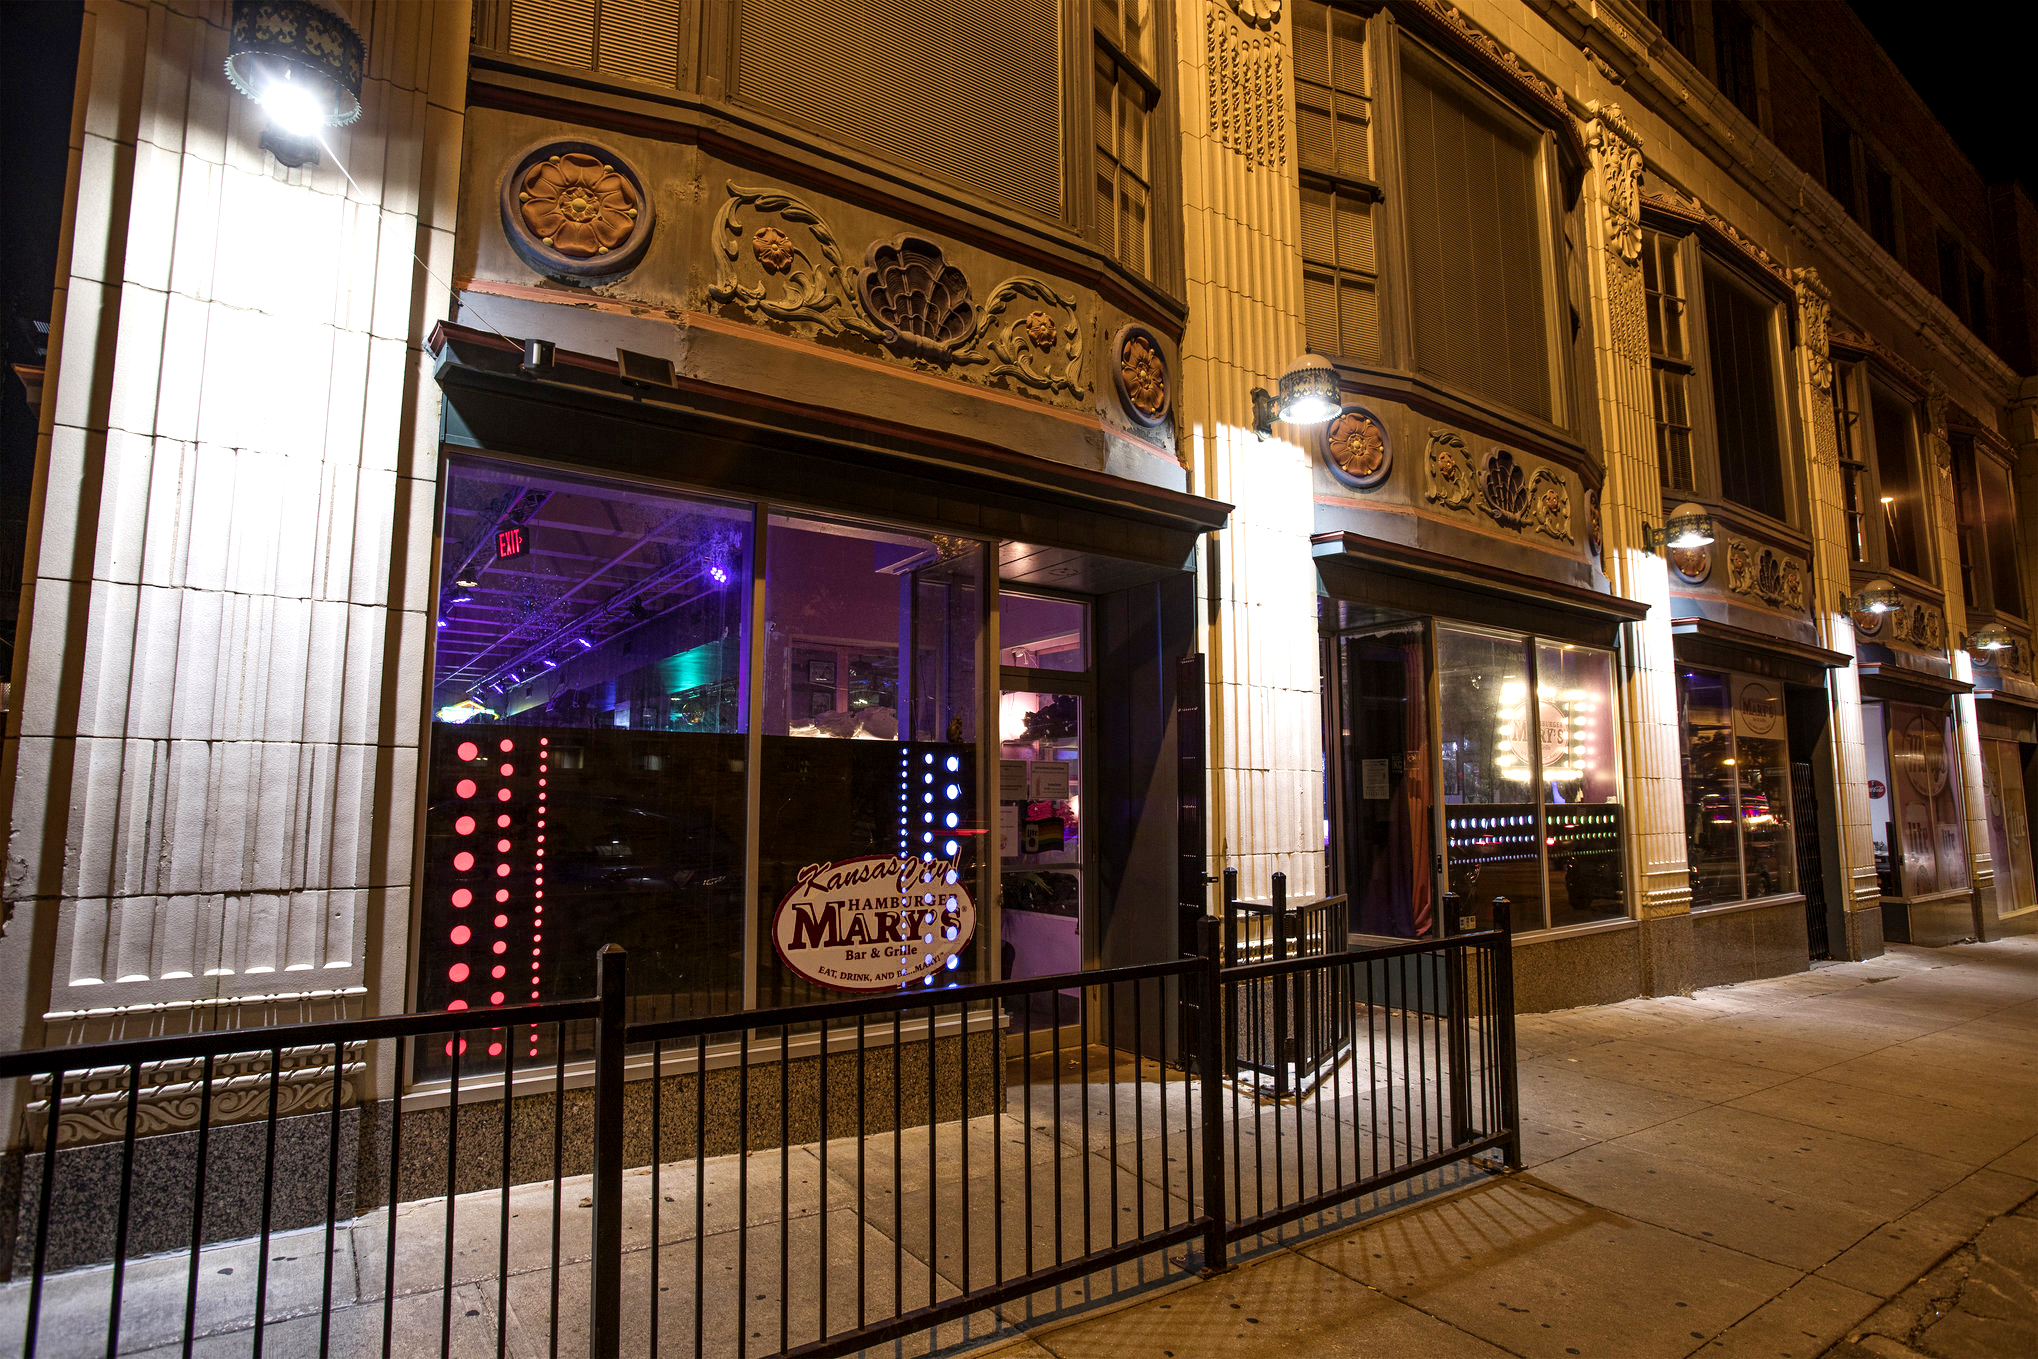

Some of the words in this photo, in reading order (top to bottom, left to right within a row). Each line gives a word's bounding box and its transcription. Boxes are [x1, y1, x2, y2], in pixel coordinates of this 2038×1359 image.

[498, 528, 520, 558] EXIT
[1512, 719, 1564, 744] MRY'S
[798, 856, 899, 897] Kansas
[787, 900, 962, 950] MARY'S
[845, 949, 867, 961] Bar
[870, 947, 881, 959] &
[884, 944, 918, 957] Grille
[818, 965, 838, 979] EAT,
[839, 971, 873, 983] DRINK,
[875, 971, 895, 982] AND
